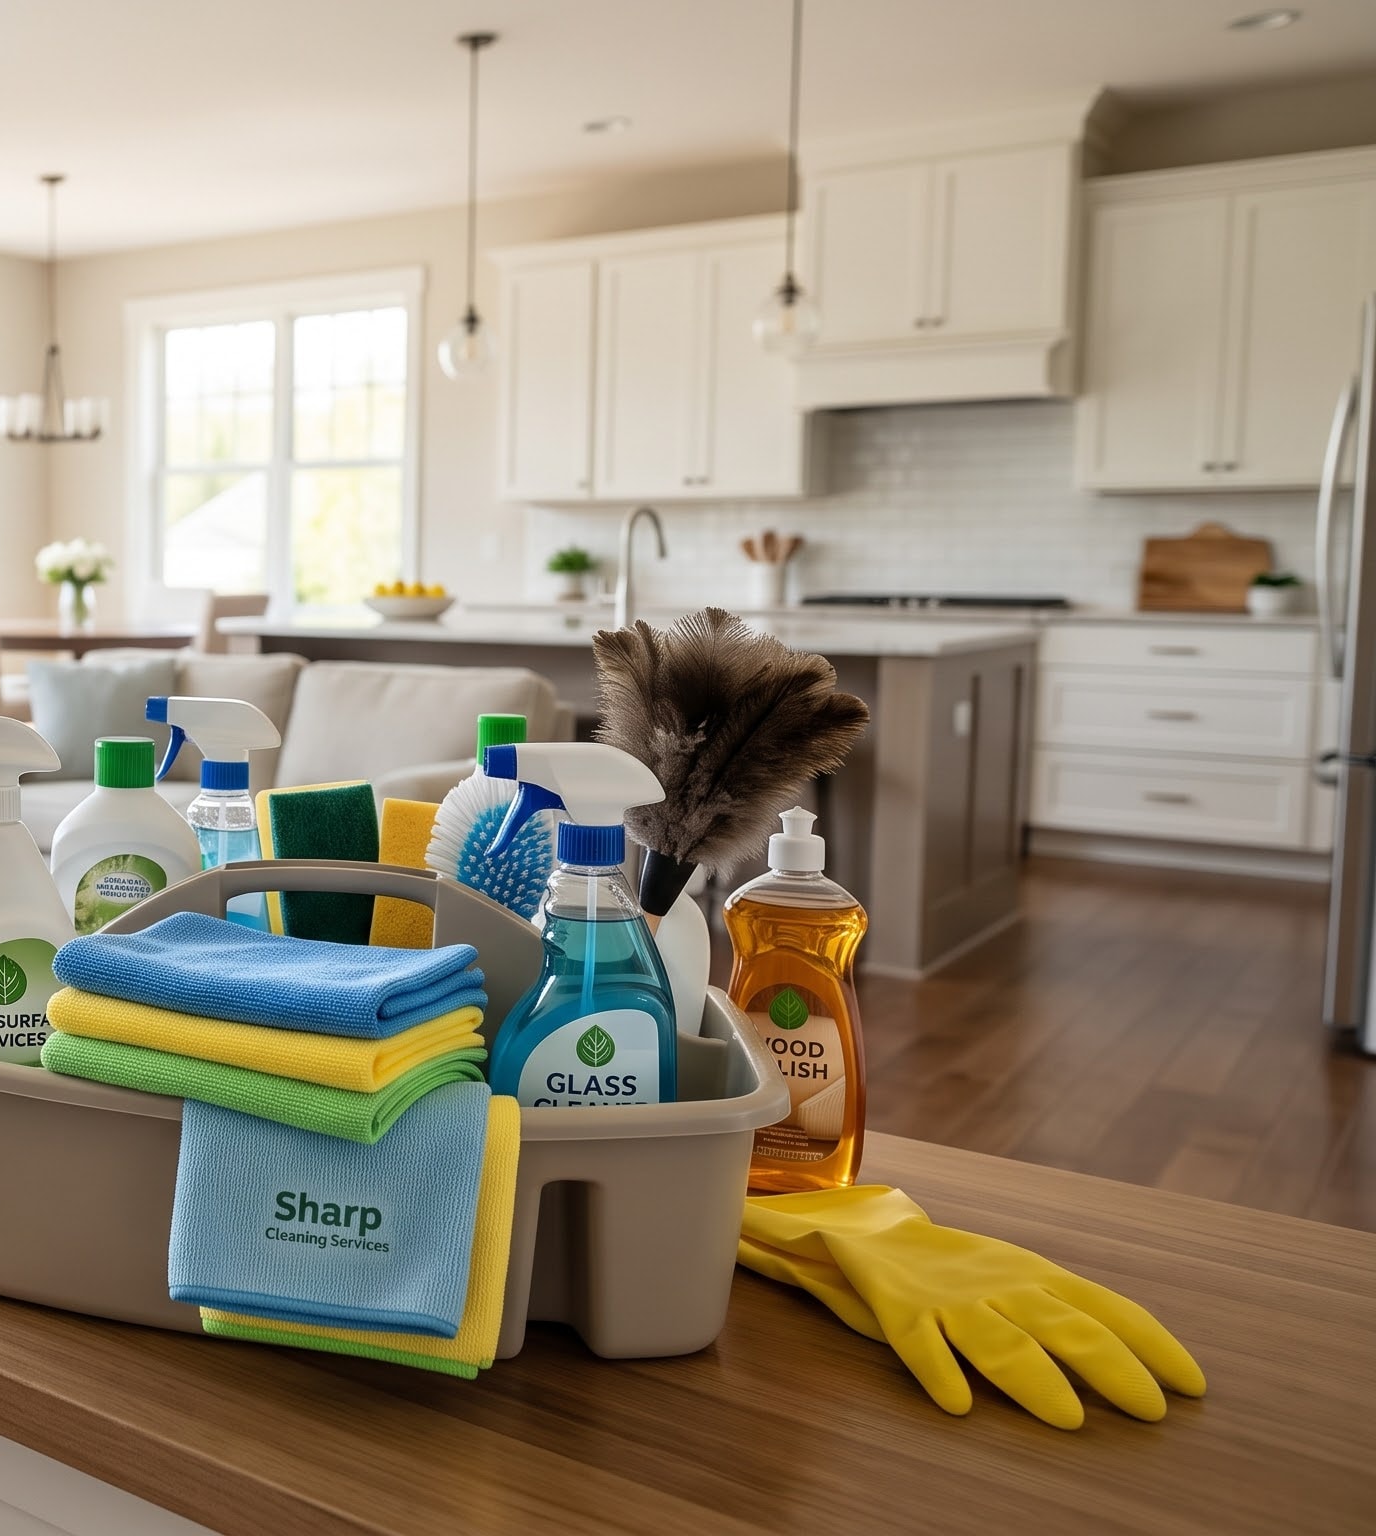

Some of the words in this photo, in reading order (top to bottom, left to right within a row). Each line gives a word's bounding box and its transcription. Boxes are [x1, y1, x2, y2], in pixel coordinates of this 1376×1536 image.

[546, 1072, 637, 1096] GLASS
[274, 1190, 382, 1237] Sharp
[265, 1227, 327, 1249] Cleaning
[330, 1234, 390, 1252] Services
